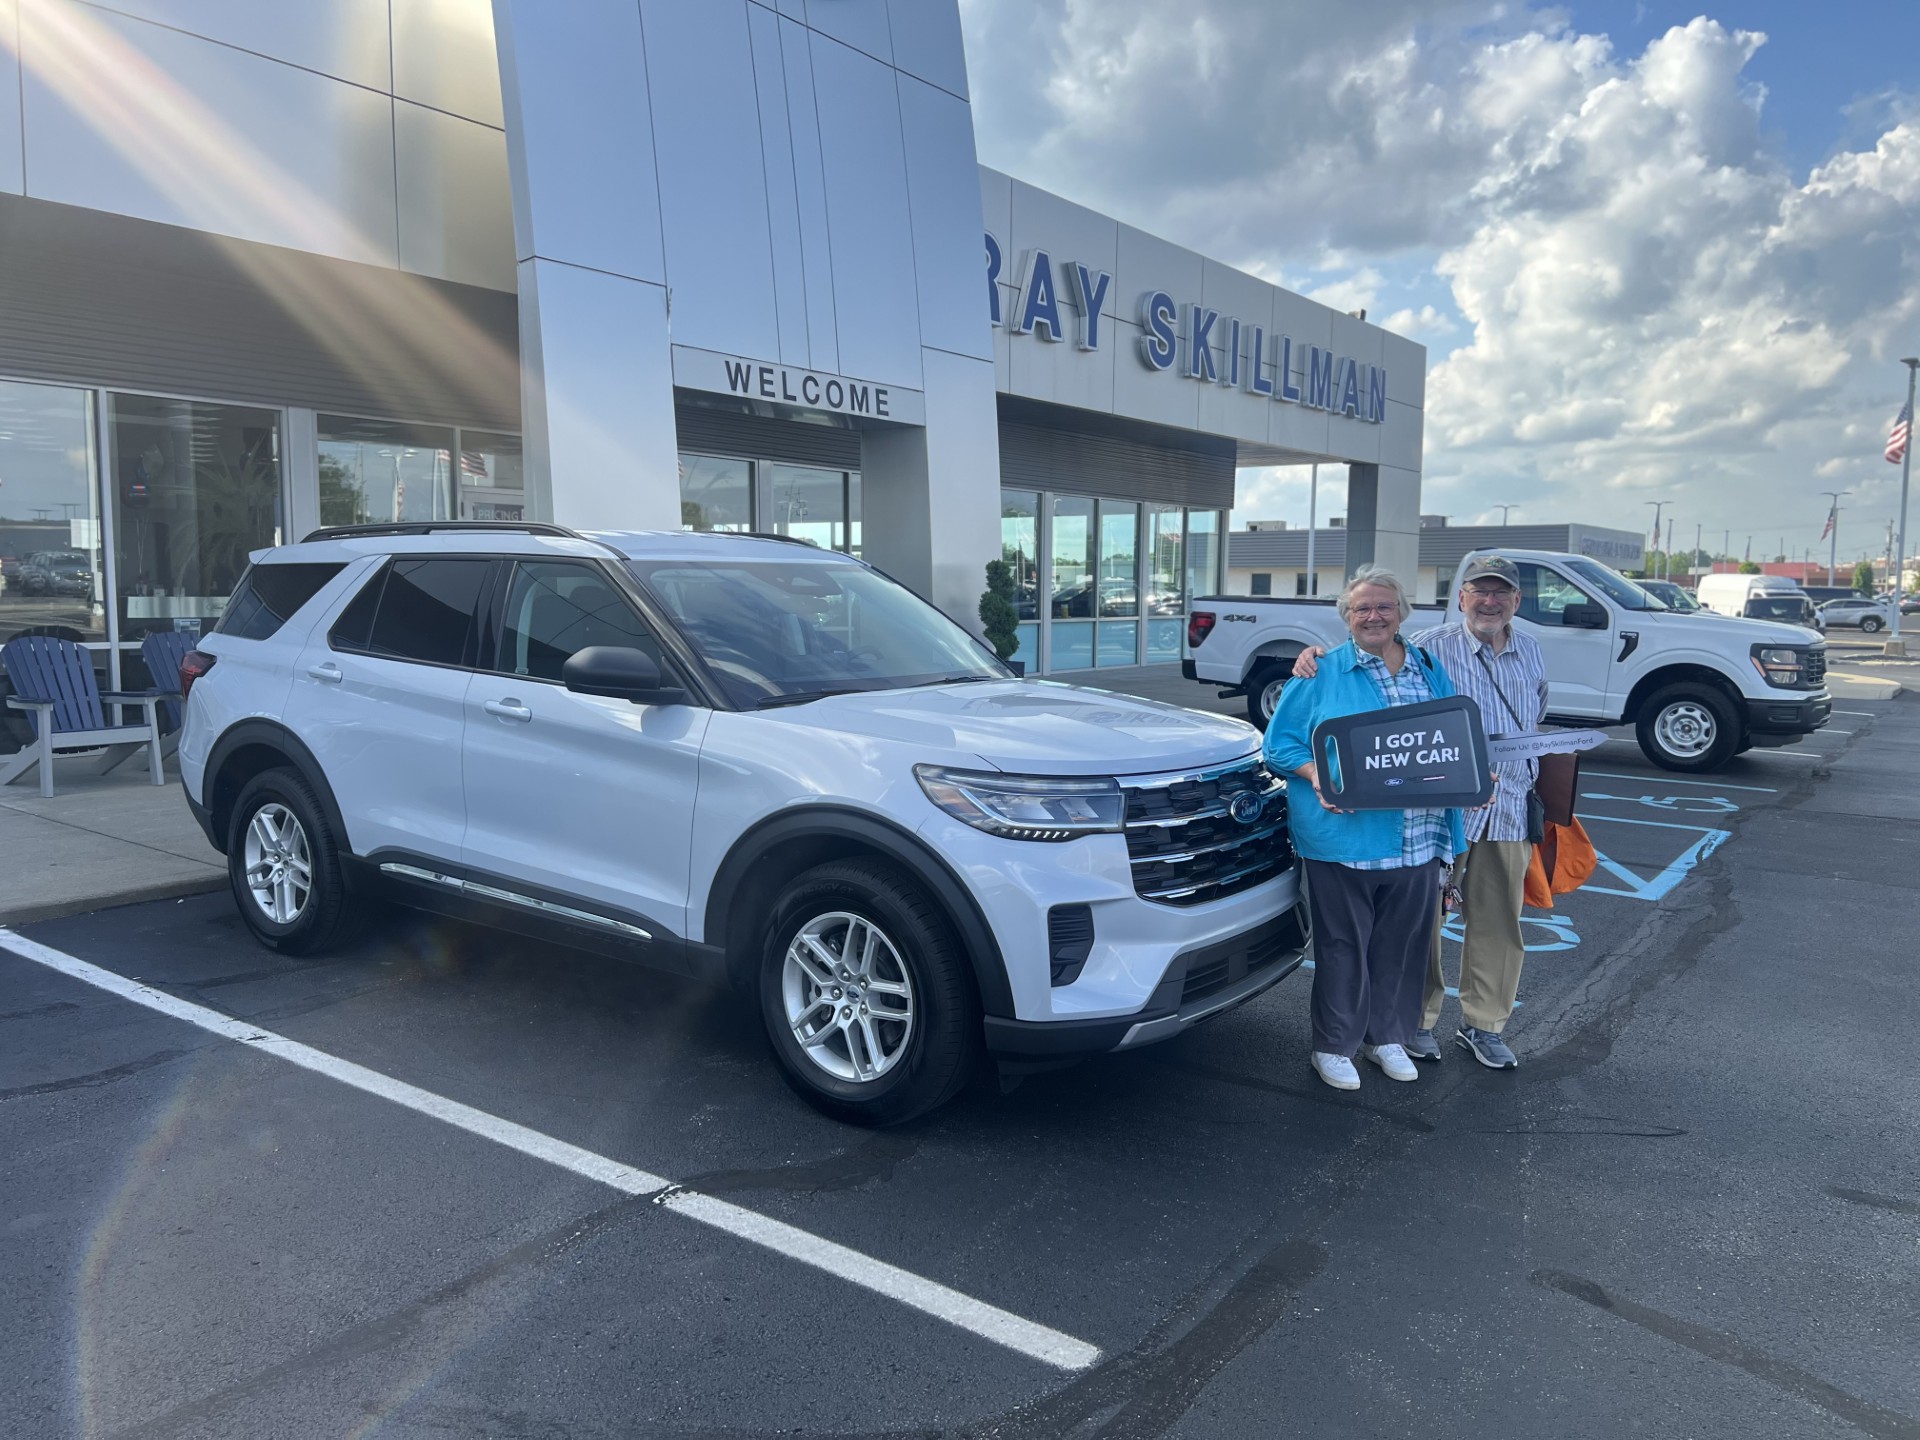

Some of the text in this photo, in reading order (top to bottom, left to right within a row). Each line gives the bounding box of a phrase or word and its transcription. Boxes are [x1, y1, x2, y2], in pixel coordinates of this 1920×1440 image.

[1141, 290, 1387, 424] SKILLMAN
[725, 360, 889, 417] WELCOME
[478, 509, 519, 520] PRICING
[1375, 730, 1445, 750] I GOT A
[1494, 744, 1517, 753] Follow
[1532, 737, 1594, 751] @RaySkillmanFord
[1365, 747, 1460, 770] NEW CAR!
